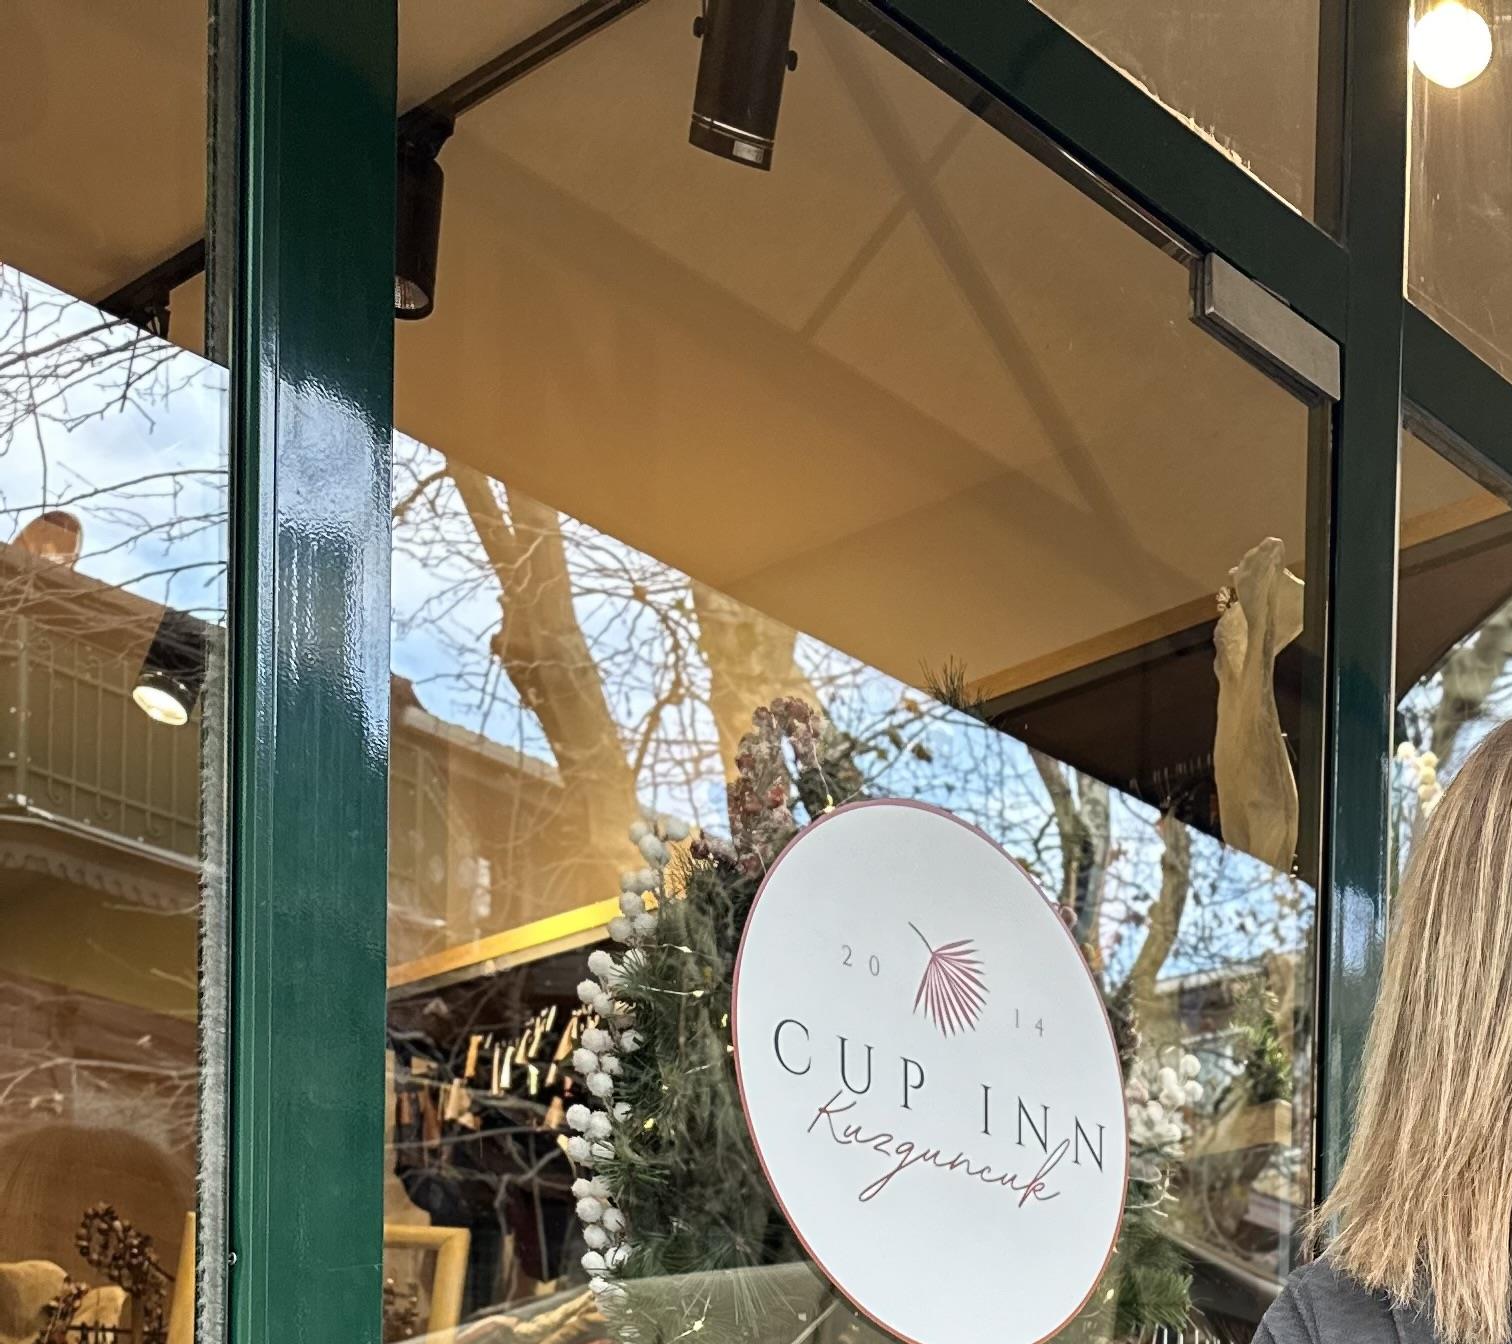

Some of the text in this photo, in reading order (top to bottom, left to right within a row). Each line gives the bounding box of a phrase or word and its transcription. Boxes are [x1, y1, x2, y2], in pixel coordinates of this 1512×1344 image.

[774, 1018, 1106, 1173] CUP INN
[807, 1089, 1071, 1208] Kuzguncuk
